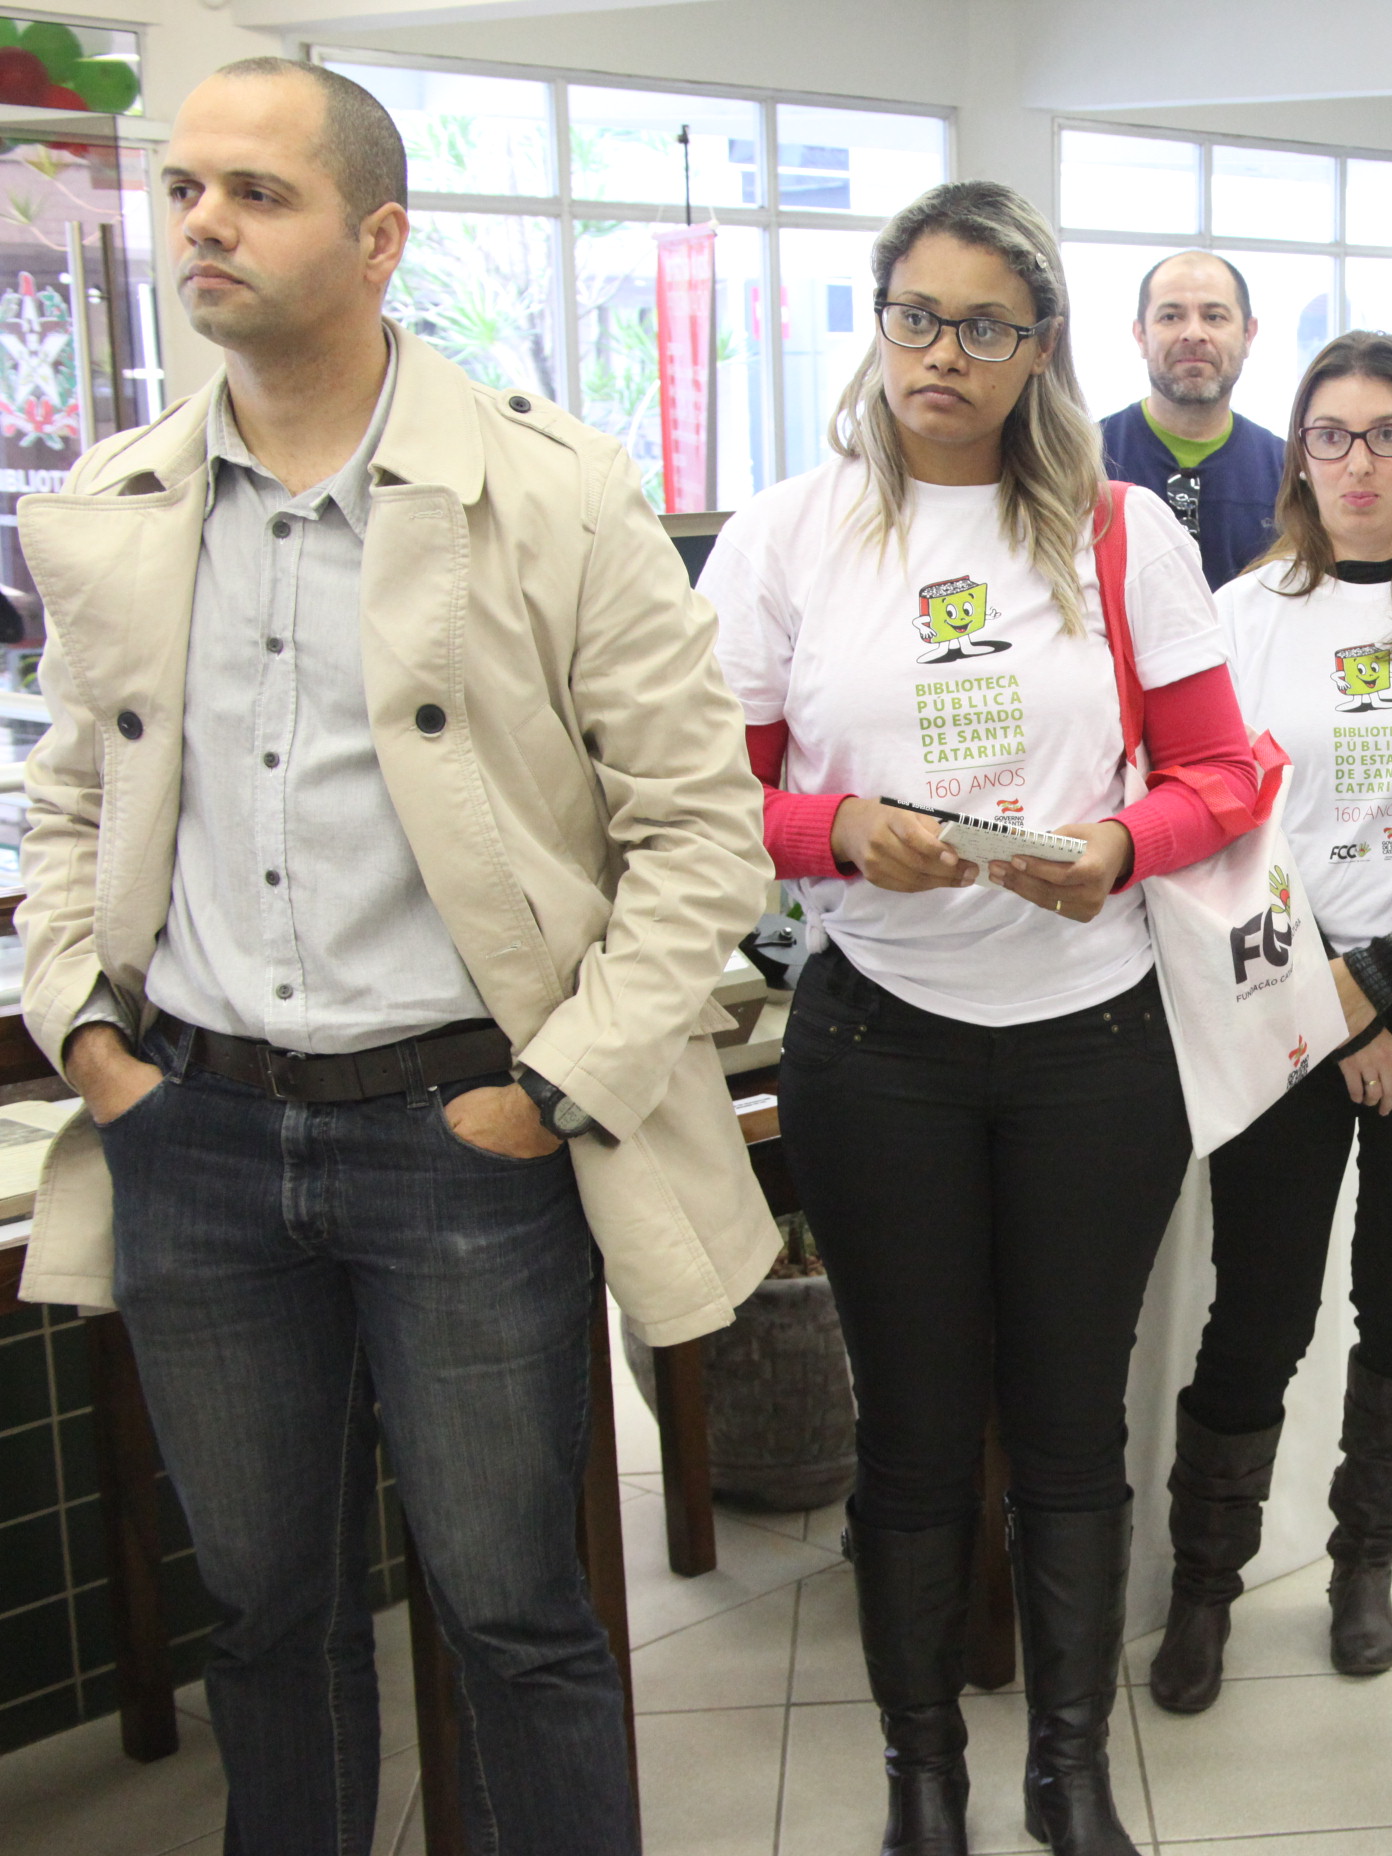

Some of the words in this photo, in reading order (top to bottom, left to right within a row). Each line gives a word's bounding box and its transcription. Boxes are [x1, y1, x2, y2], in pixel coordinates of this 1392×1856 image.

[915, 674, 1020, 697] BIBLIOTECA
[917, 691, 1023, 714] PÚBLICA
[919, 715, 947, 731] DO
[951, 708, 1024, 727] ESTADO
[921, 731, 948, 748] DE
[956, 724, 1025, 744] SANTA
[923, 741, 1026, 764] CATARINA
[1335, 754, 1356, 766] DO
[926, 777, 961, 799] 160
[968, 767, 1026, 794] ANOS
[1335, 768, 1356, 780] DE
[1334, 806, 1361, 823] 160
[1329, 844, 1357, 860] FCC
